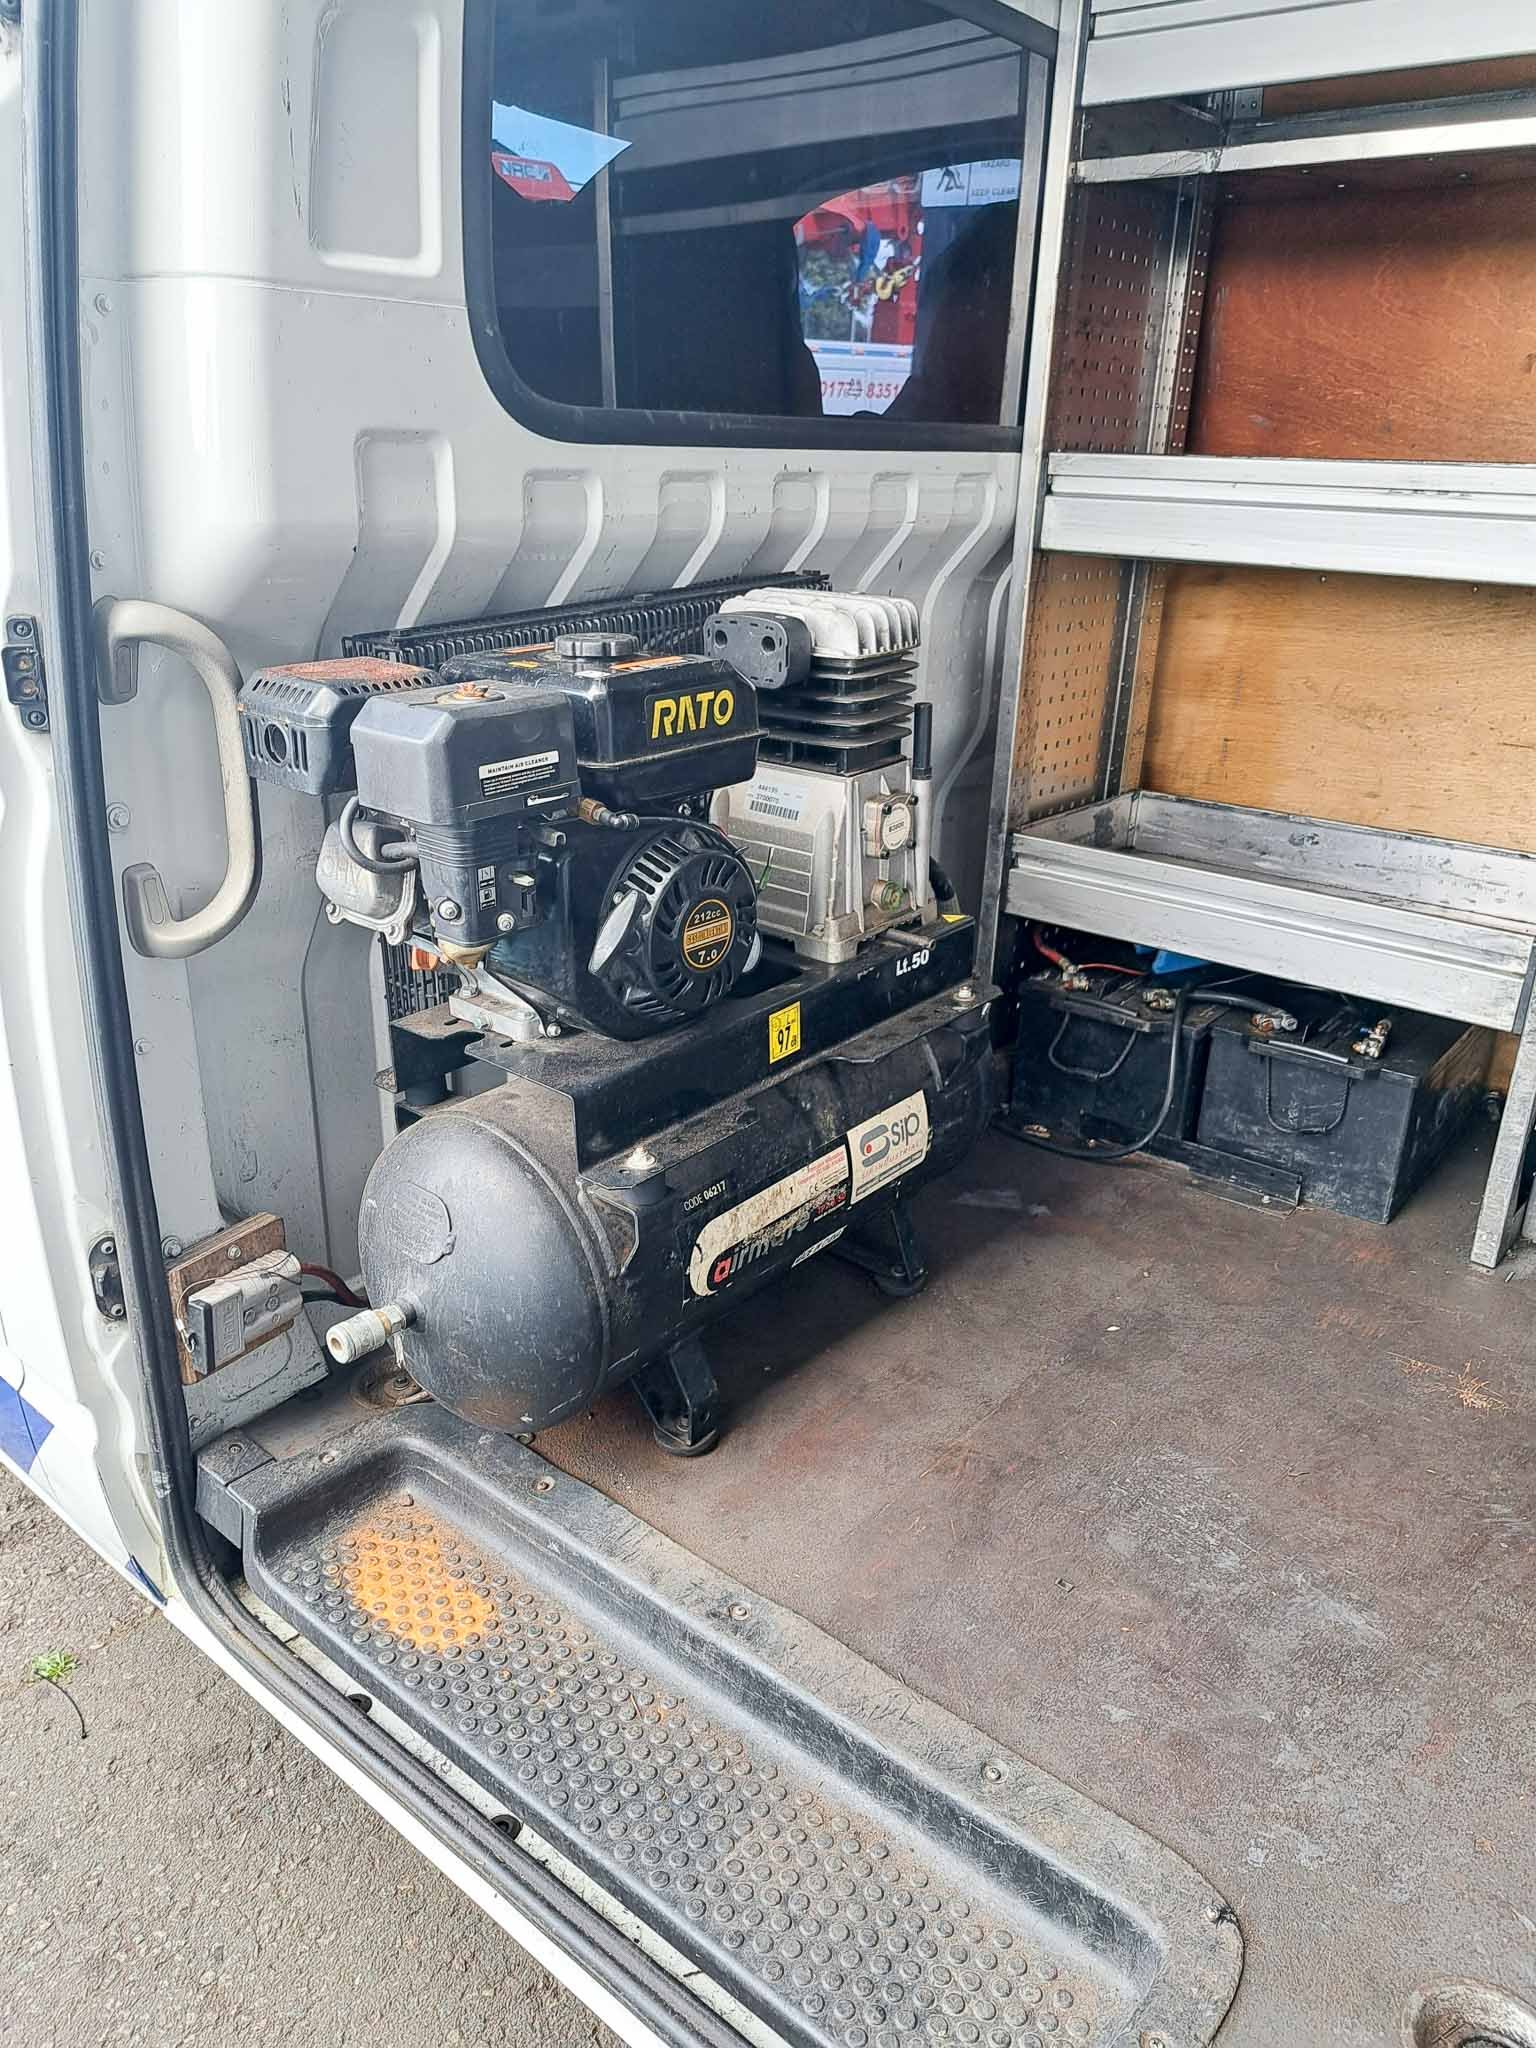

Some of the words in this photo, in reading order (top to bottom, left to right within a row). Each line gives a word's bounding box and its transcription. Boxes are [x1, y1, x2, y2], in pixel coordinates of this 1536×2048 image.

[652, 689, 734, 739] RATO
[694, 909, 721, 924] 212cc
[698, 949, 718, 963] 7.0
[896, 949, 930, 977] Lt.50
[777, 1025, 791, 1053] 97
[891, 1113, 920, 1146] sip
[684, 1193, 704, 1213] CODE
[704, 1181, 727, 1201] 06217
